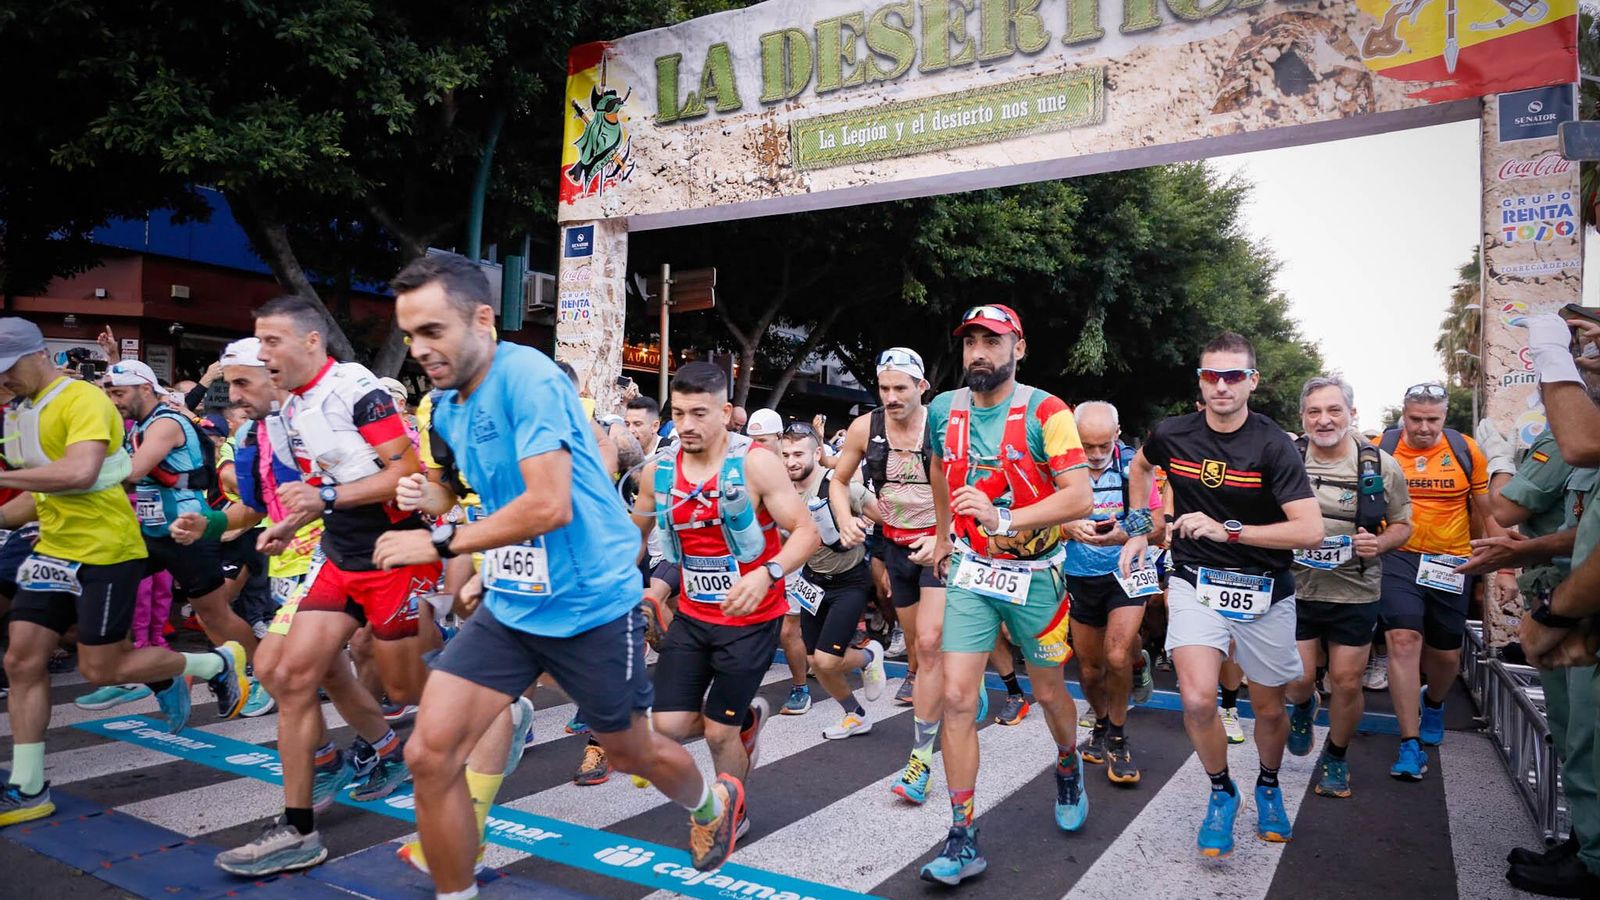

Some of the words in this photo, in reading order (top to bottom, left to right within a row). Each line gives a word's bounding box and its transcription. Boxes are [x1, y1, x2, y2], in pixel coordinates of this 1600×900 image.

[655, 42, 743, 124] LA
[759, 0, 1265, 104] DESERT
[819, 130, 836, 150] La
[842, 122, 888, 148] Legión
[895, 122, 904, 142] y
[912, 113, 925, 134] el
[933, 105, 994, 130] desierto
[1002, 100, 1029, 120] nos
[1037, 93, 1068, 114] une
[1514, 113, 1557, 125] SENATOR
[1503, 192, 1571, 207] GRUPO
[1503, 203, 1574, 224] RENTA
[1502, 220, 1575, 242] TODO
[561, 299, 590, 309] RENTA
[1503, 373, 1536, 387] prim
[494, 550, 534, 577] 1466
[1305, 547, 1341, 562] 3341
[32, 563, 72, 583] 2082
[693, 574, 733, 592] 1008
[974, 567, 1019, 593] 3405
[797, 580, 817, 604] 3488
[1219, 590, 1254, 611] 985
[653, 862, 818, 900] cajama
